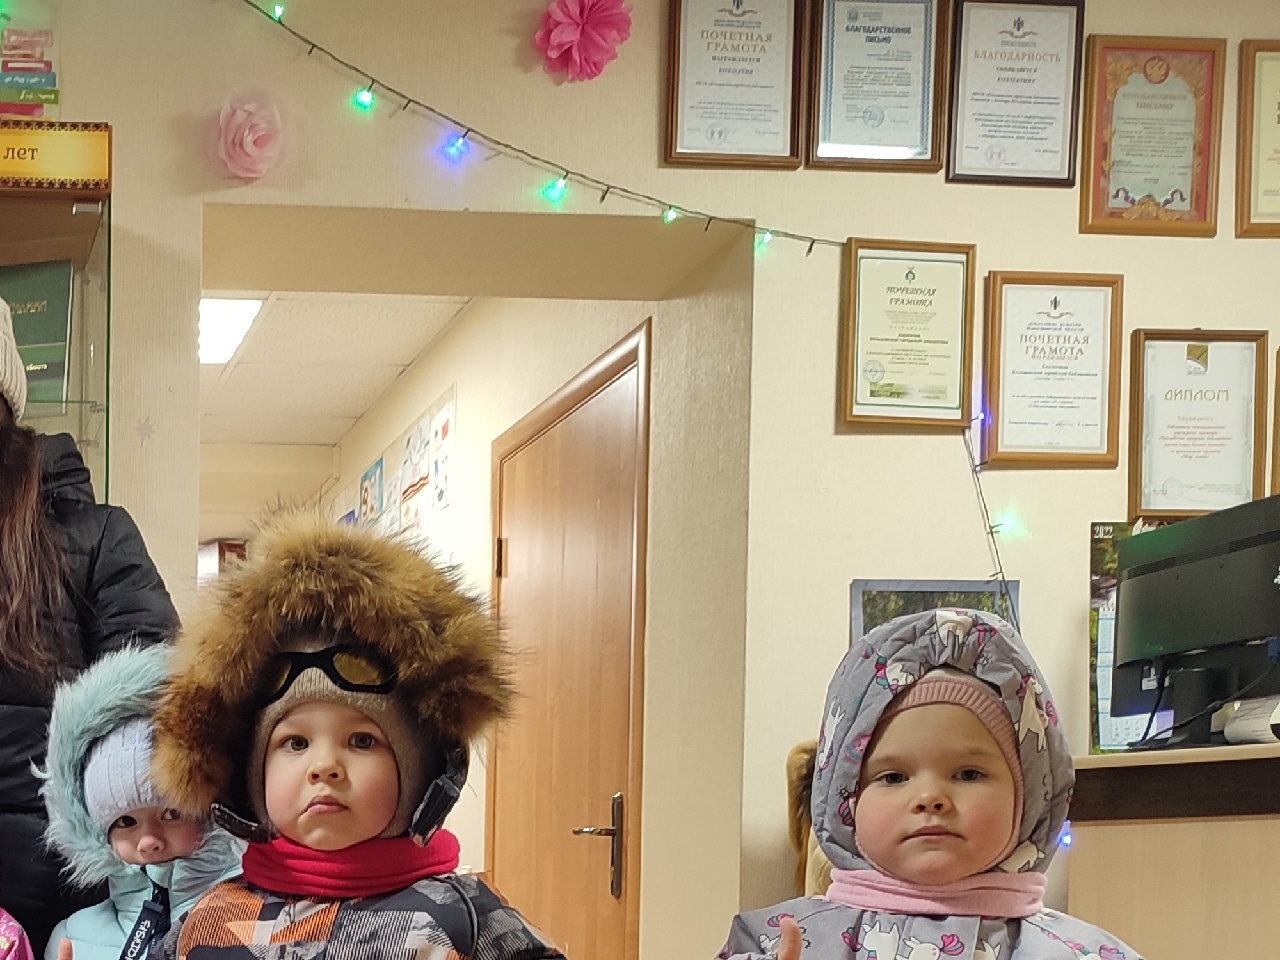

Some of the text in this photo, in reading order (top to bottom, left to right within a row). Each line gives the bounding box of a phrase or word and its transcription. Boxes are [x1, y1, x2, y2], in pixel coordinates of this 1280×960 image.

[845, 25, 912, 34] БЛАГОДАРСТВЕННОЕ
[701, 30, 773, 42] ПОЧЕТНАЯ
[865, 35, 892, 44] ПИСЬМО
[706, 41, 767, 53] ГРАМОТА
[973, 49, 1061, 62] БЛАГОДАРНОСТЬ
[3, 145, 39, 161] лет
[1020, 334, 1089, 345] ПОЧЕТНАЯ
[1025, 345, 1084, 355] ГРАМОТА
[1164, 389, 1229, 401] ДИПЛОМ
[1093, 525, 1113, 538] 2022
